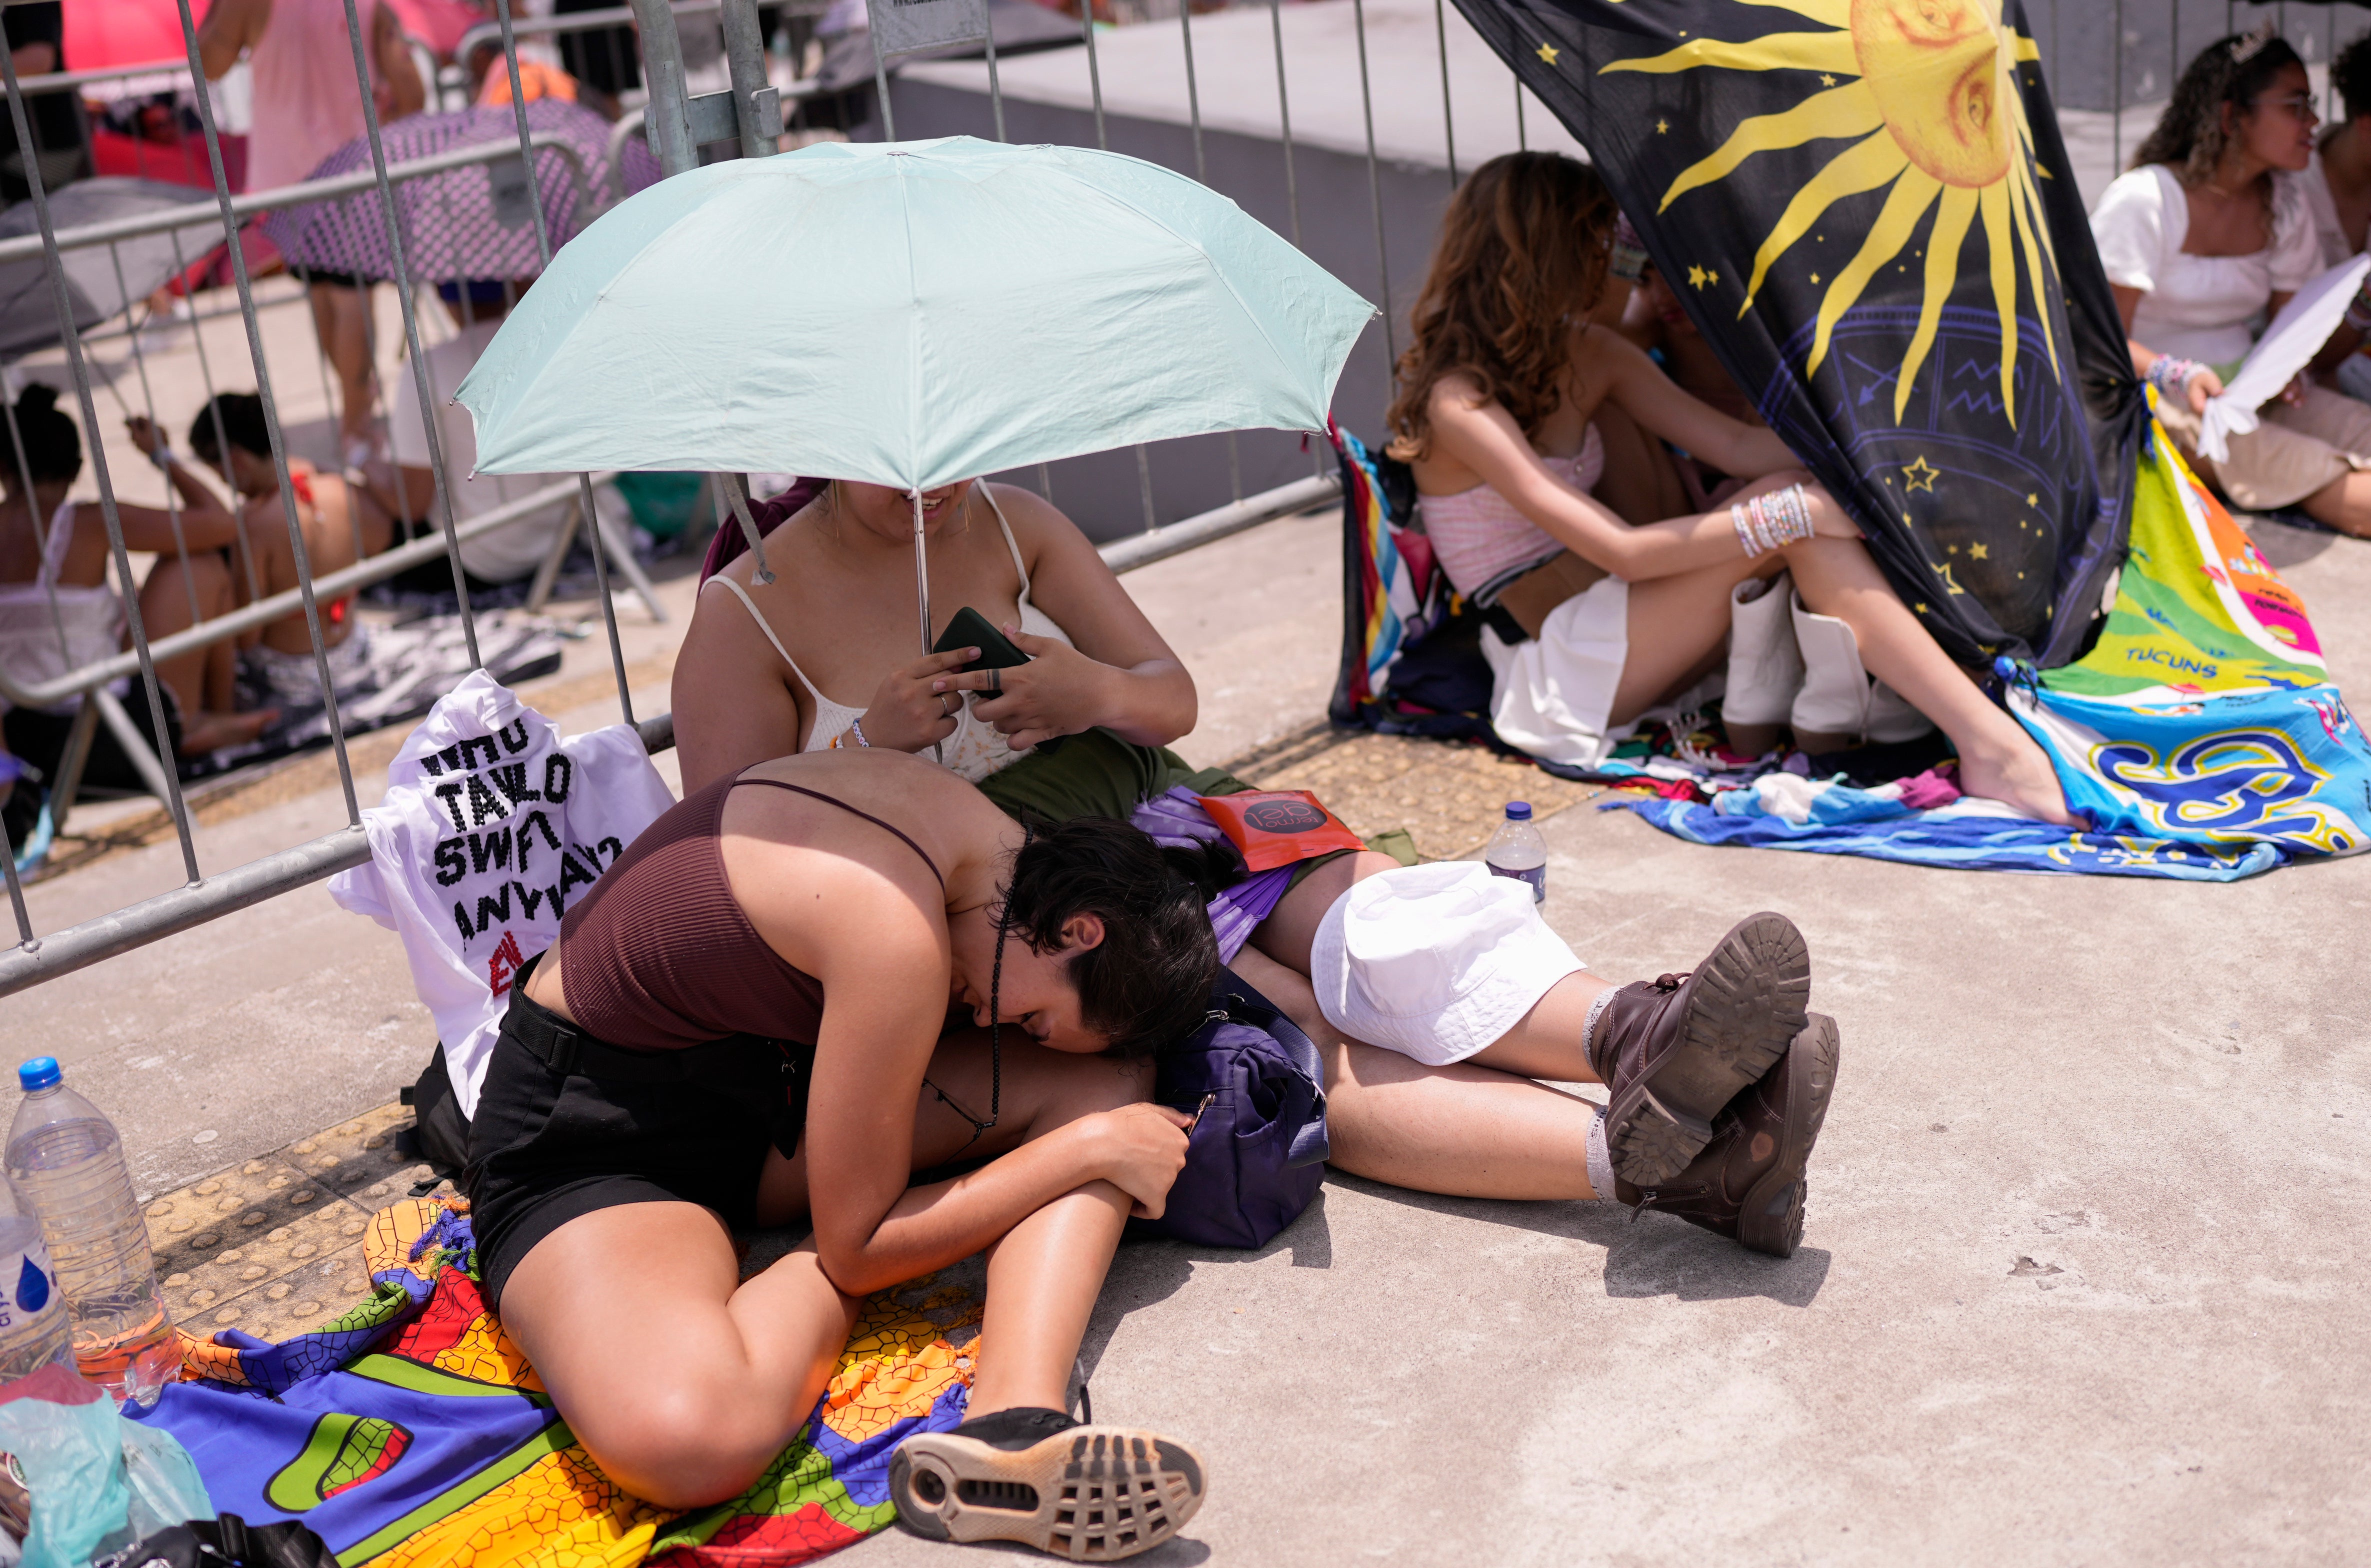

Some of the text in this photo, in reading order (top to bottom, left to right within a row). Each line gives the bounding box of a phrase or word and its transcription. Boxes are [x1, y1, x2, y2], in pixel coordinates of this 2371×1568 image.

[2127, 648, 2217, 678] TUCUNS
[435, 753, 571, 832] TAYLO
[1244, 802, 1312, 827] gel
[1266, 816, 1319, 828] termo
